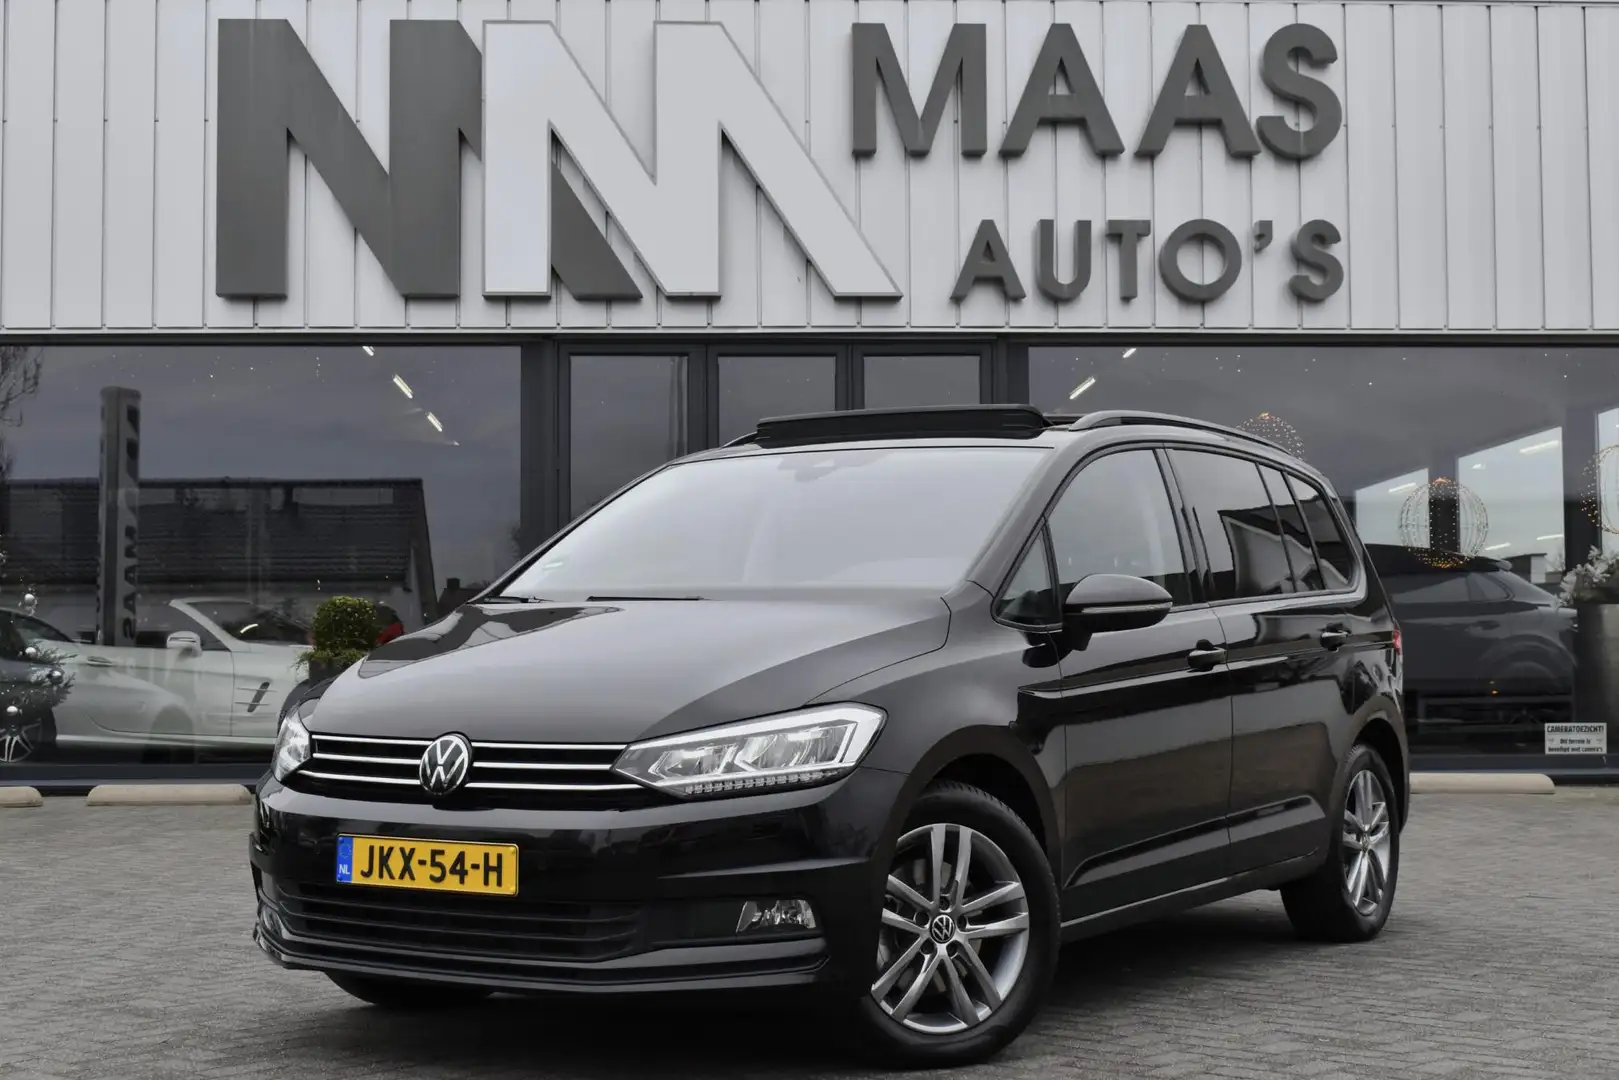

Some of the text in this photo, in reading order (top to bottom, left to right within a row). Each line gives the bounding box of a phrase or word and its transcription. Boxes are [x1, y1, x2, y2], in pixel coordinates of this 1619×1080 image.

[852, 22, 1343, 160] MAAS
[949, 219, 1344, 302] AUTO'S
[338, 863, 351, 876] NL
[360, 845, 503, 887] JKX-54-H
